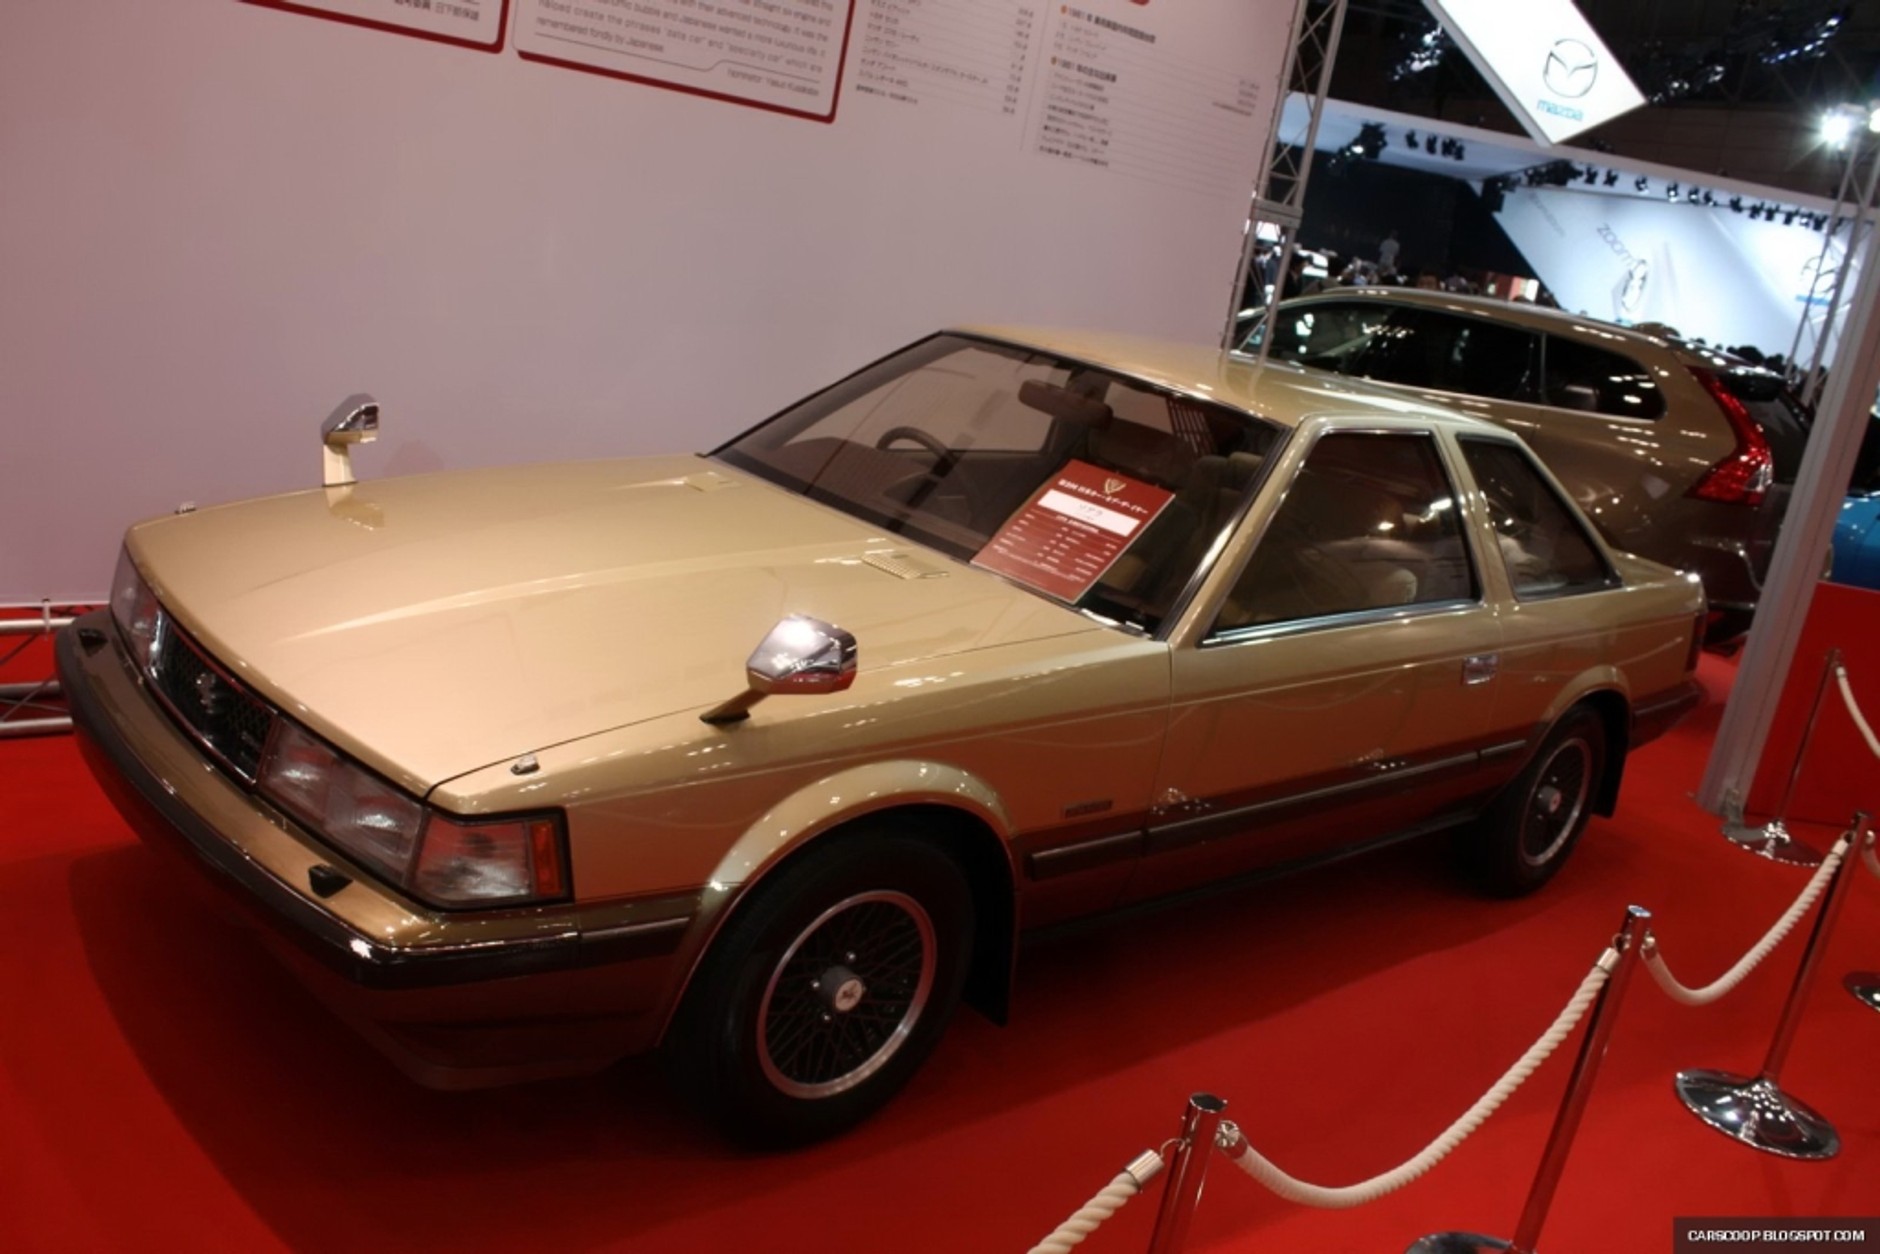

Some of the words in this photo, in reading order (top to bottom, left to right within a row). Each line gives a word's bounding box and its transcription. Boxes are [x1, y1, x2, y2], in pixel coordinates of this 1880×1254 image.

[536, 16, 589, 36] remembered
[626, 37, 664, 53] Japanese
[1537, 99, 1584, 121] mazda
